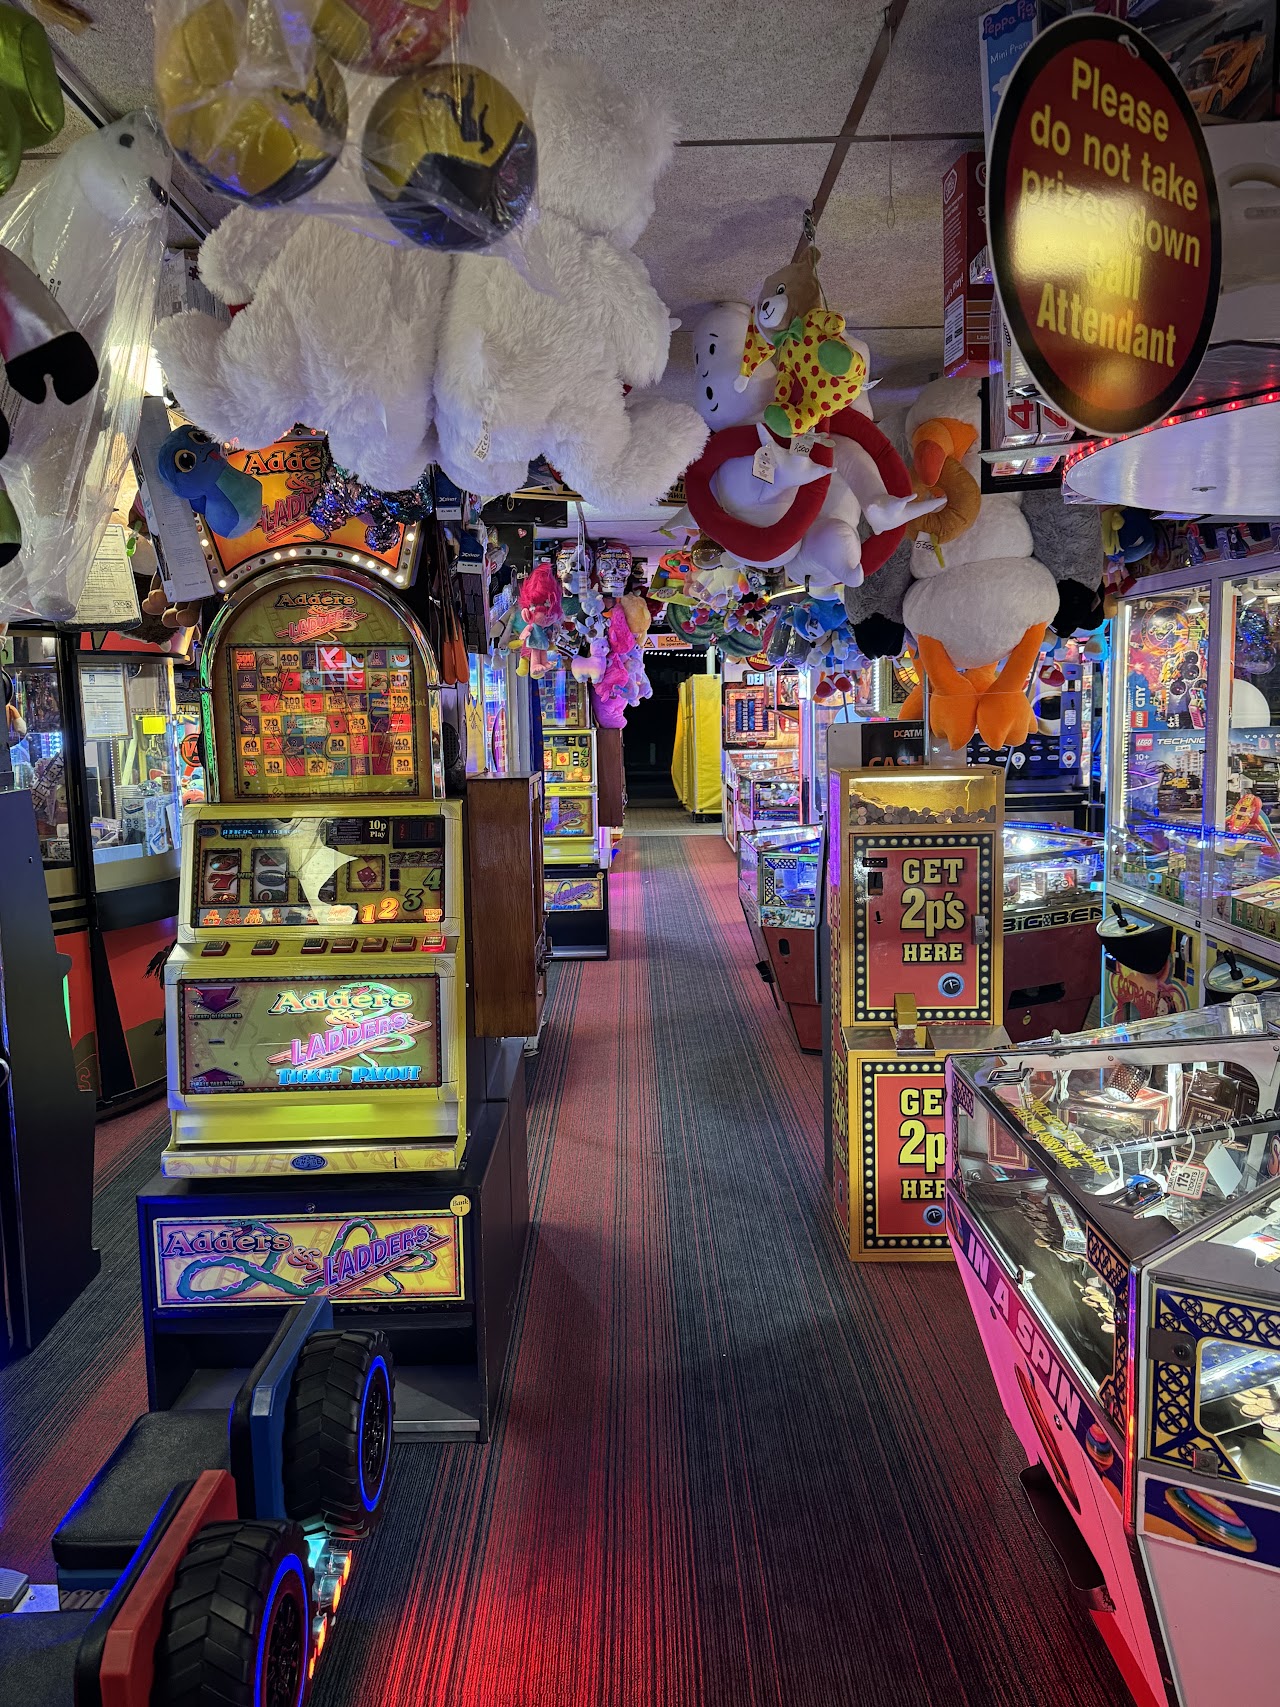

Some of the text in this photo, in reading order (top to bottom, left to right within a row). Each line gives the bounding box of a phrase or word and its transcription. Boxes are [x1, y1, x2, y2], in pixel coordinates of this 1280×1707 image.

[984, 0, 1034, 36] Peppa Pig
[990, 50, 1008, 64] Mini
[1072, 57, 1170, 143] Please
[1030, 105, 1198, 212] do not take
[1022, 168, 1118, 232] prizes
[1128, 206, 1201, 267] down
[1037, 283, 1177, 368] Attendant
[244, 451, 321, 475] Adde
[275, 593, 356, 608] Adders
[288, 607, 355, 638] LADDERS
[280, 654, 299, 662] 400
[1135, 685, 1146, 727] LEGO CITY
[1167, 716, 1174, 728] 6+
[395, 738, 409, 747] 40
[1157, 737, 1205, 745] TECHNIC
[267, 762, 280, 770] 10
[396, 759, 409, 768] 30
[368, 820, 387, 830] 10p
[423, 867, 442, 891] 4
[902, 857, 965, 884] GET
[378, 897, 399, 919] 2
[402, 888, 424, 911] 3
[361, 904, 376, 923] 1
[900, 887, 965, 938] 2p's
[902, 943, 963, 963] HERE
[267, 989, 413, 1015] Adders
[325, 1008, 364, 1029] &
[291, 1012, 413, 1066] LADDERS
[276, 1065, 420, 1085] TICKET PAYOUT
[900, 1088, 945, 1117] GE
[899, 1119, 945, 1174] 2p
[1038, 1132, 1083, 1169] ASSISTANCE
[1081, 1149, 1114, 1175] PLEASE
[1176, 1172, 1191, 1187] 175
[1188, 1171, 1198, 1191] TICKETS
[452, 1198, 468, 1206] Bank
[161, 1230, 294, 1259] Adders
[322, 1223, 434, 1288] LADDERS
[287, 1246, 321, 1269] &
[966, 1237, 1081, 1430] IN A SPIN
